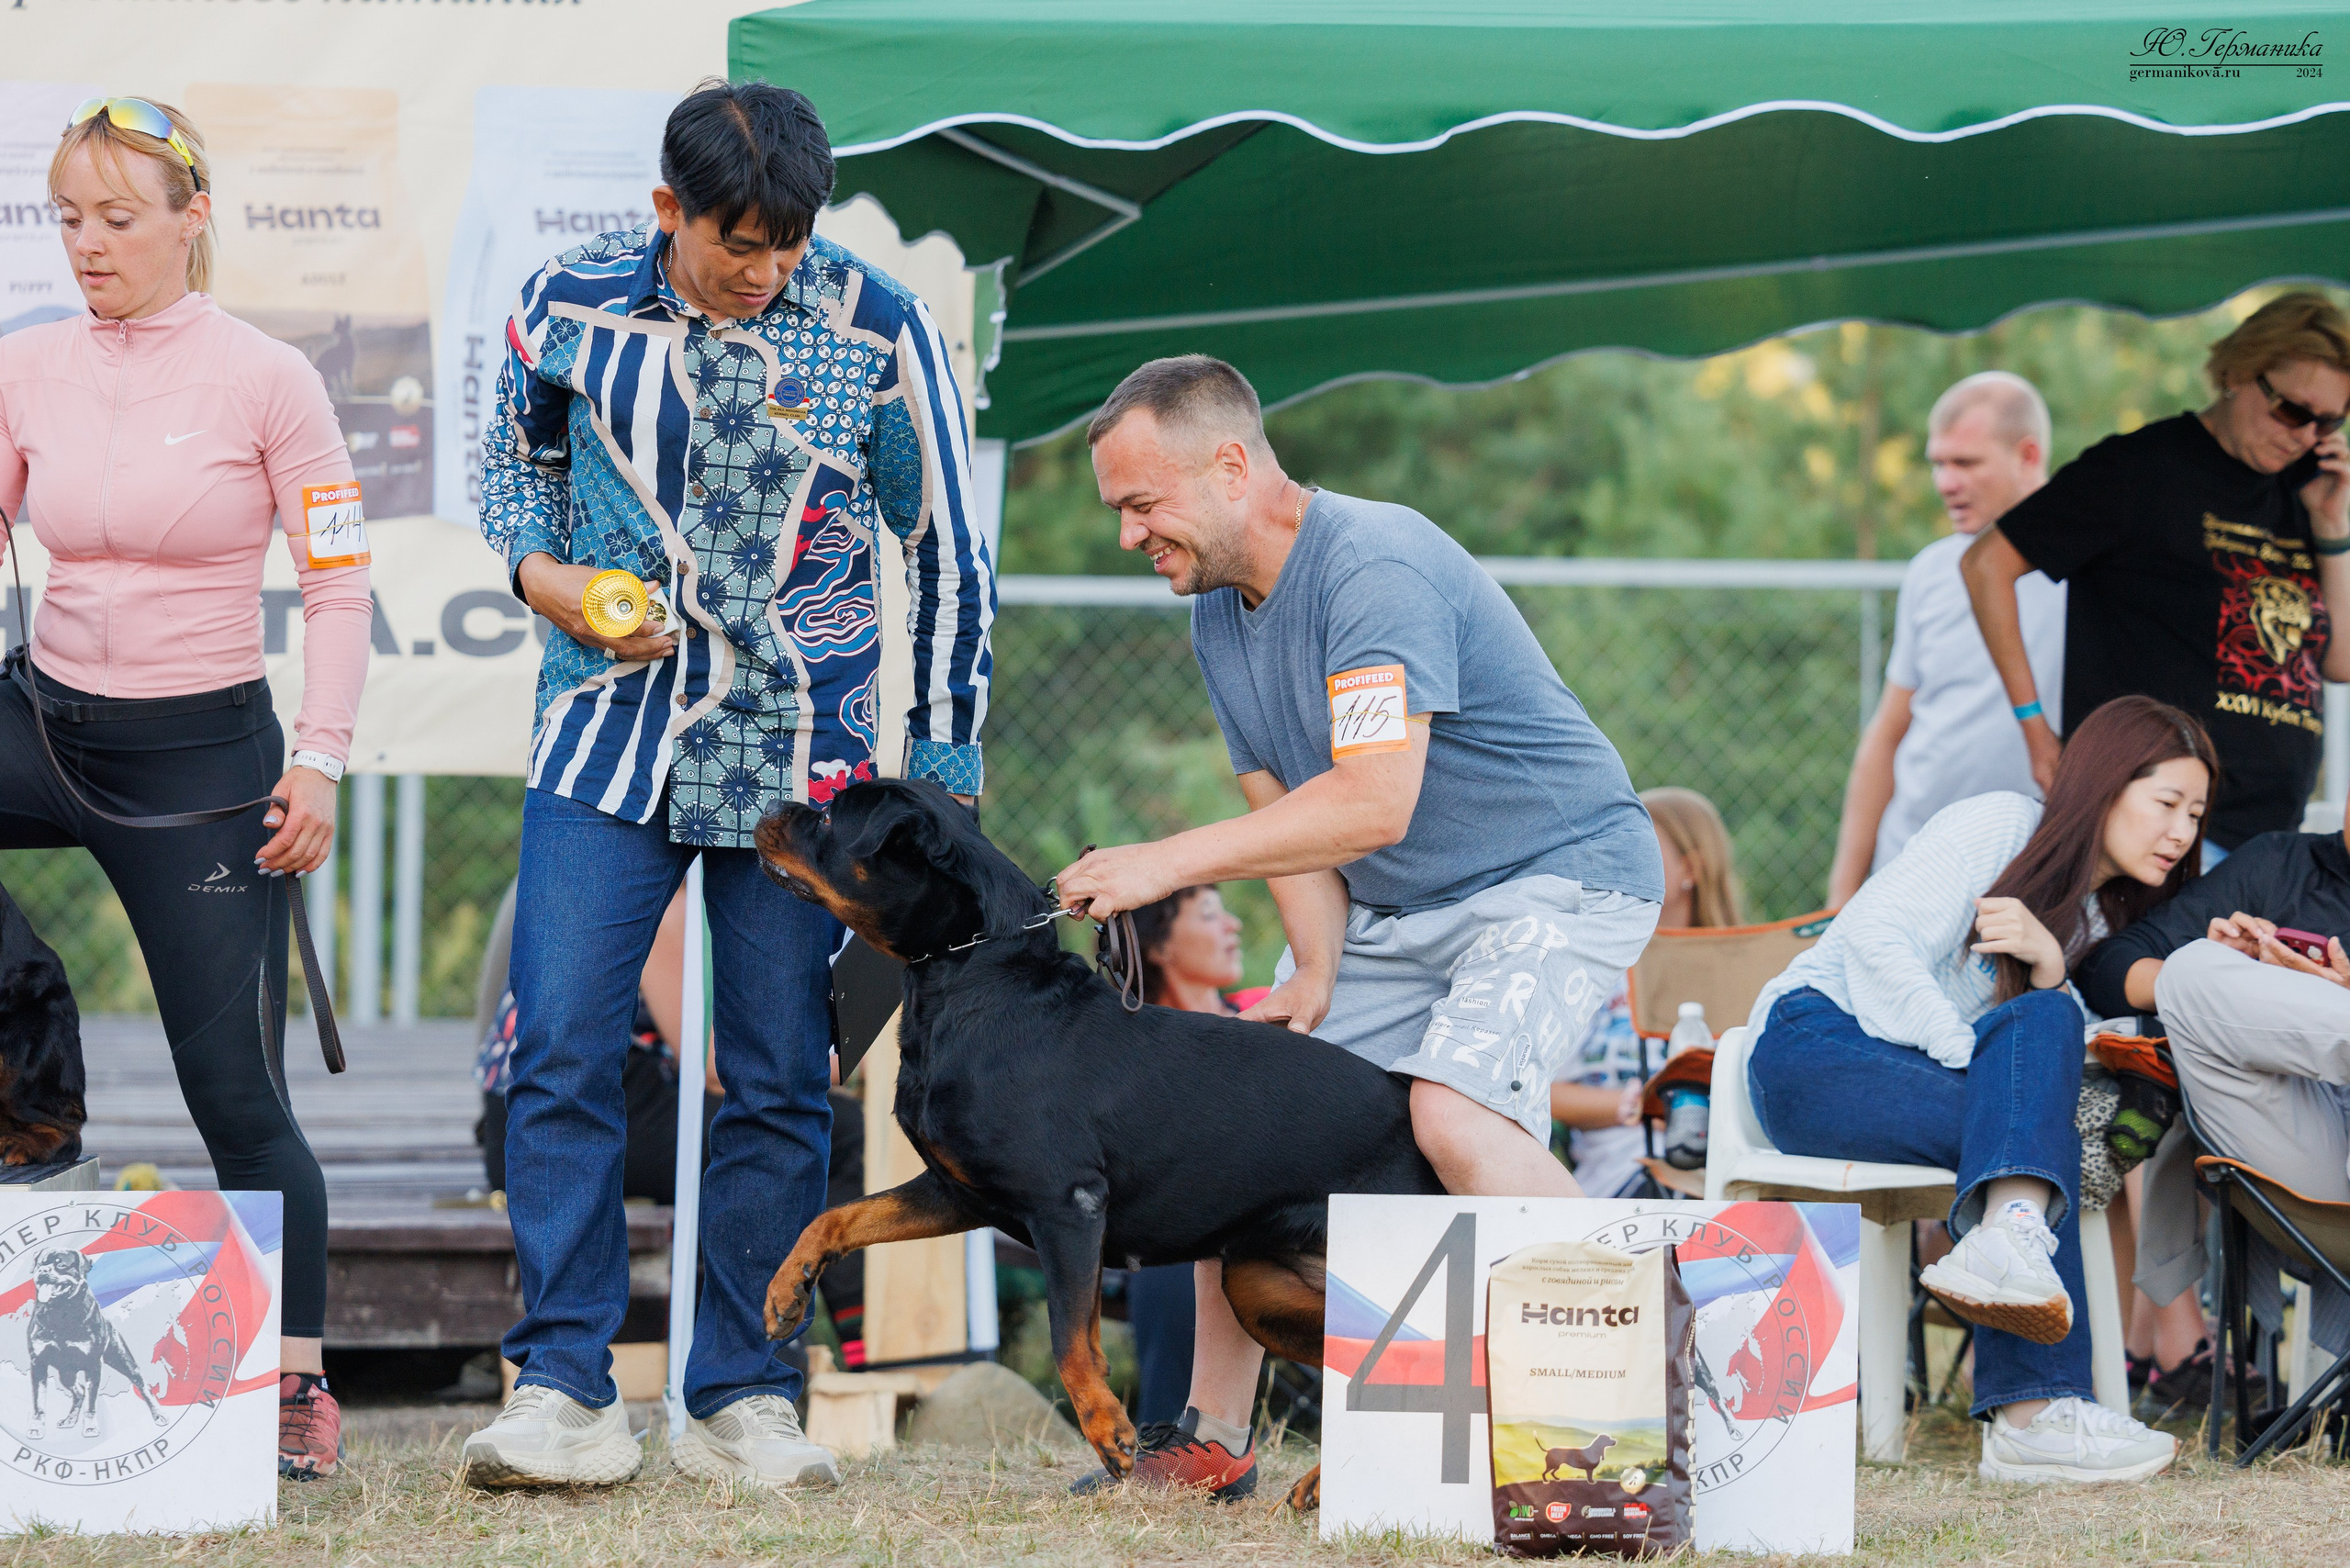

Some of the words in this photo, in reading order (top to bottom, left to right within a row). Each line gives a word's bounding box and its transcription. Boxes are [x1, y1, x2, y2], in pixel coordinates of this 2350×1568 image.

[245, 203, 382, 230] Hanta
[535, 207, 657, 234] Hant
[464, 334, 485, 503] Hanta
[1338, 694, 1397, 741] 115
[187, 883, 249, 893] DEMIX
[1461, 995, 1490, 1007] fashion
[1548, 1275, 1592, 1285] говядиной
[84, 1209, 182, 1252] КЛУБ
[187, 1260, 231, 1410] РОССИИ
[1521, 1302, 1639, 1327] Hanta
[1662, 1218, 1757, 1264] КЛУБ
[1763, 1273, 1806, 1425] РОССИИ
[1346, 1212, 1488, 1484] 4
[1558, 1330, 1606, 1339] premium
[1529, 1367, 1627, 1379] SMALL/MEDIUM
